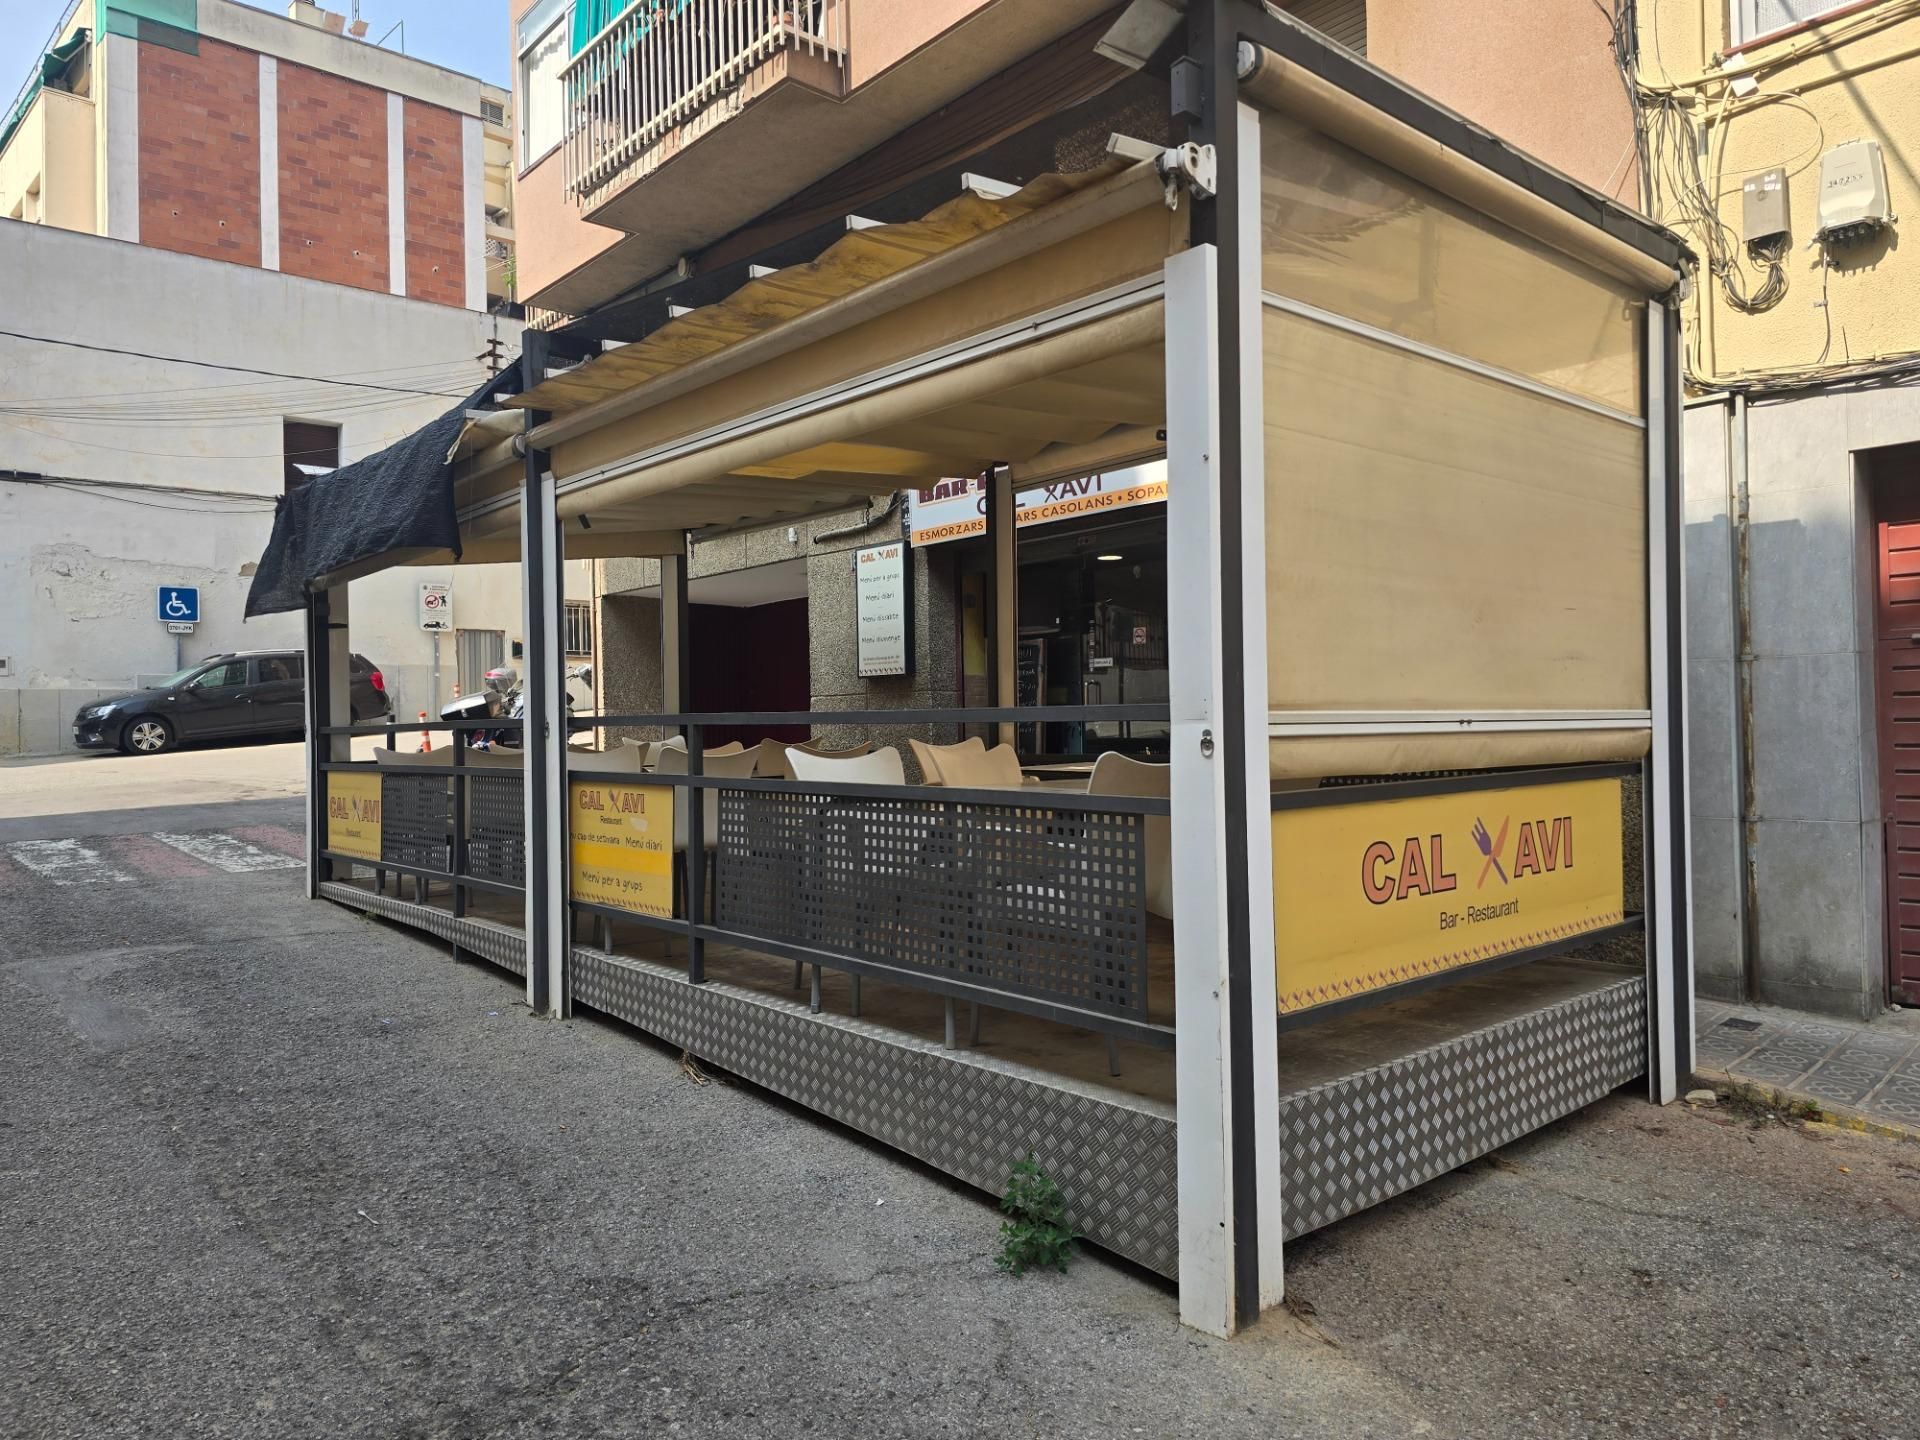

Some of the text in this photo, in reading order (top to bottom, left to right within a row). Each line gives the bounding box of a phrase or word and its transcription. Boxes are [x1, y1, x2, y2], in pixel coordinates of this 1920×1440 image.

[1042, 495, 1113, 518] CASOLANS
[1127, 485, 1168, 501] SOPA
[920, 520, 984, 542] ESMORZARS
[860, 553, 875, 564] CAL
[330, 796, 349, 820] CAL
[580, 790, 605, 811] CAL
[1361, 834, 1457, 904] CAL
[602, 876, 614, 888] per
[616, 878, 621, 887] a
[622, 880, 643, 892] grups
[1440, 911, 1458, 930] Bar
[1467, 897, 1519, 926] Restaurant
